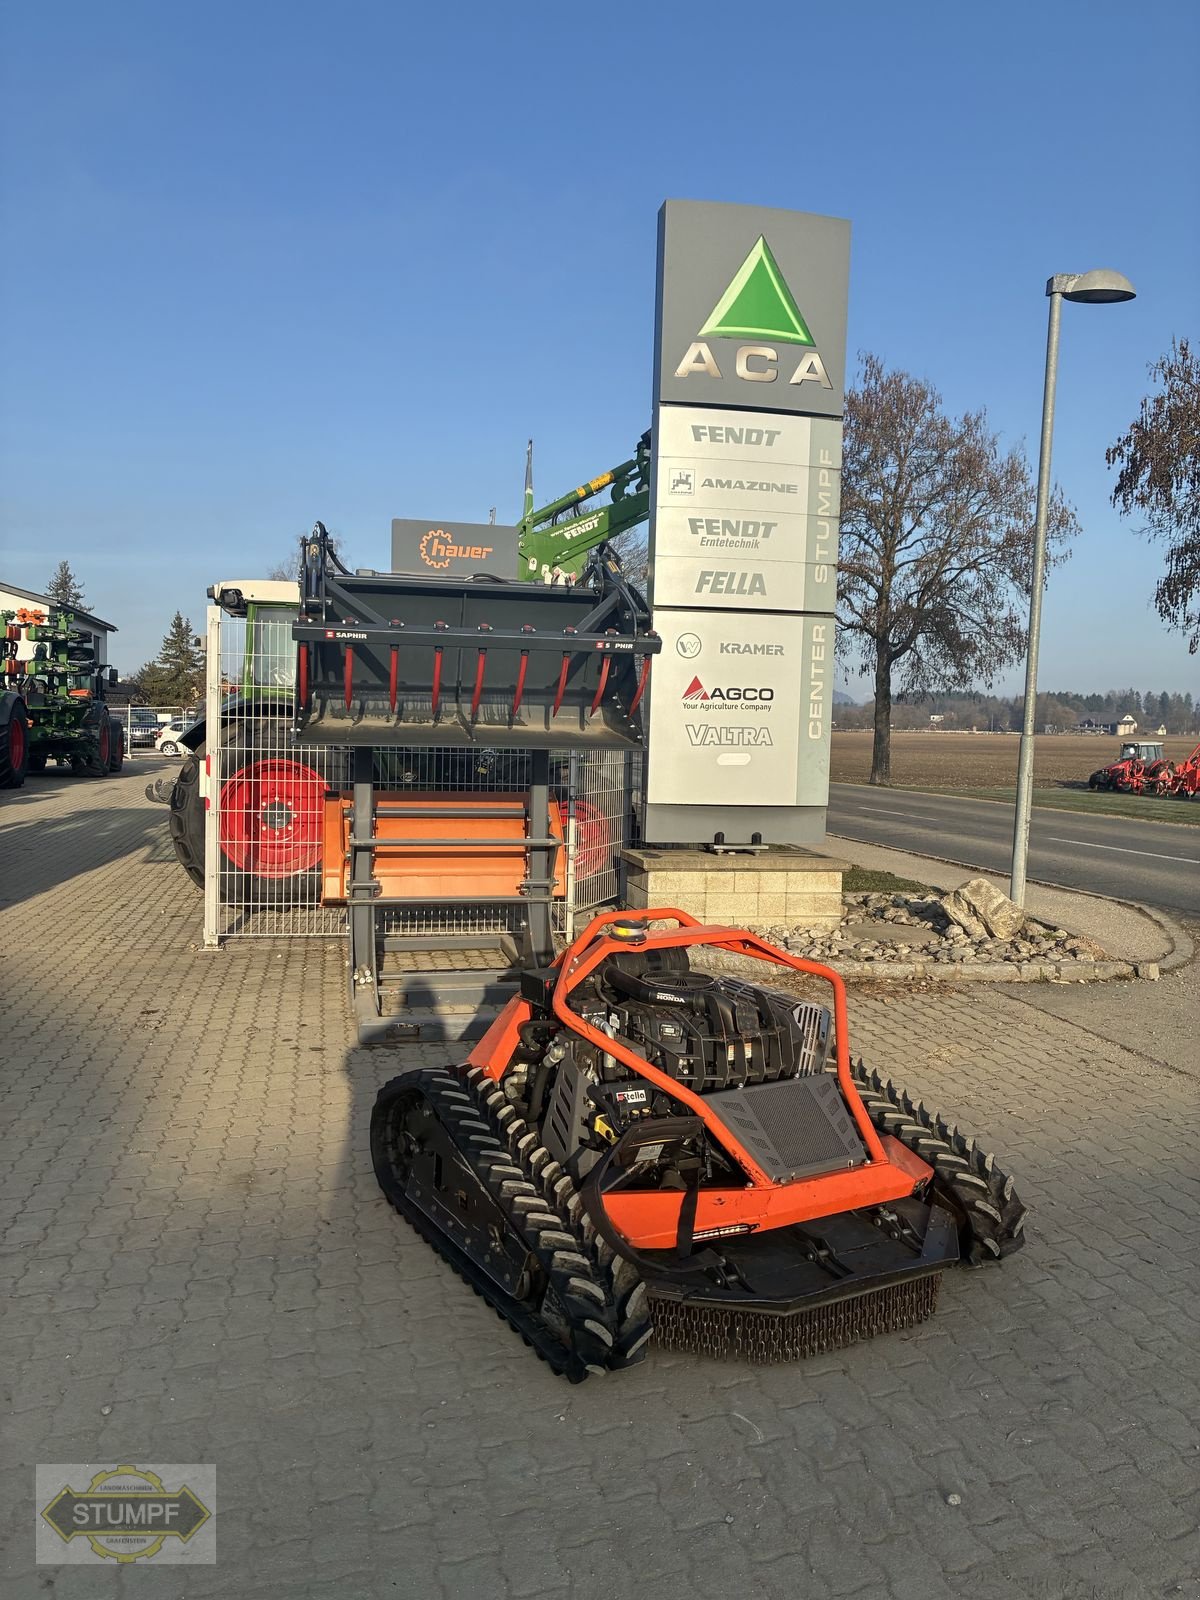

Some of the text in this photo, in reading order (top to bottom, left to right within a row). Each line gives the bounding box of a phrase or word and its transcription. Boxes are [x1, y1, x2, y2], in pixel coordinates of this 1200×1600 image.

[673, 342, 833, 390] ACA
[691, 425, 782, 446] FENDT
[701, 478, 798, 494] AMAZONE
[563, 518, 599, 540] FENDT
[687, 517, 778, 539] FENDT
[431, 538, 493, 559] hauer
[700, 536, 760, 549] Erntetechnik
[694, 570, 767, 596] FELLA
[808, 448, 833, 740] CENTER STUMPF
[335, 631, 368, 640] SAPHIR
[719, 642, 785, 656] KRAMER
[710, 687, 774, 701] AGCO
[682, 702, 772, 713] Your Agriculture Company
[685, 724, 774, 746] VALTRA
[656, 994, 686, 1004] HONDA
